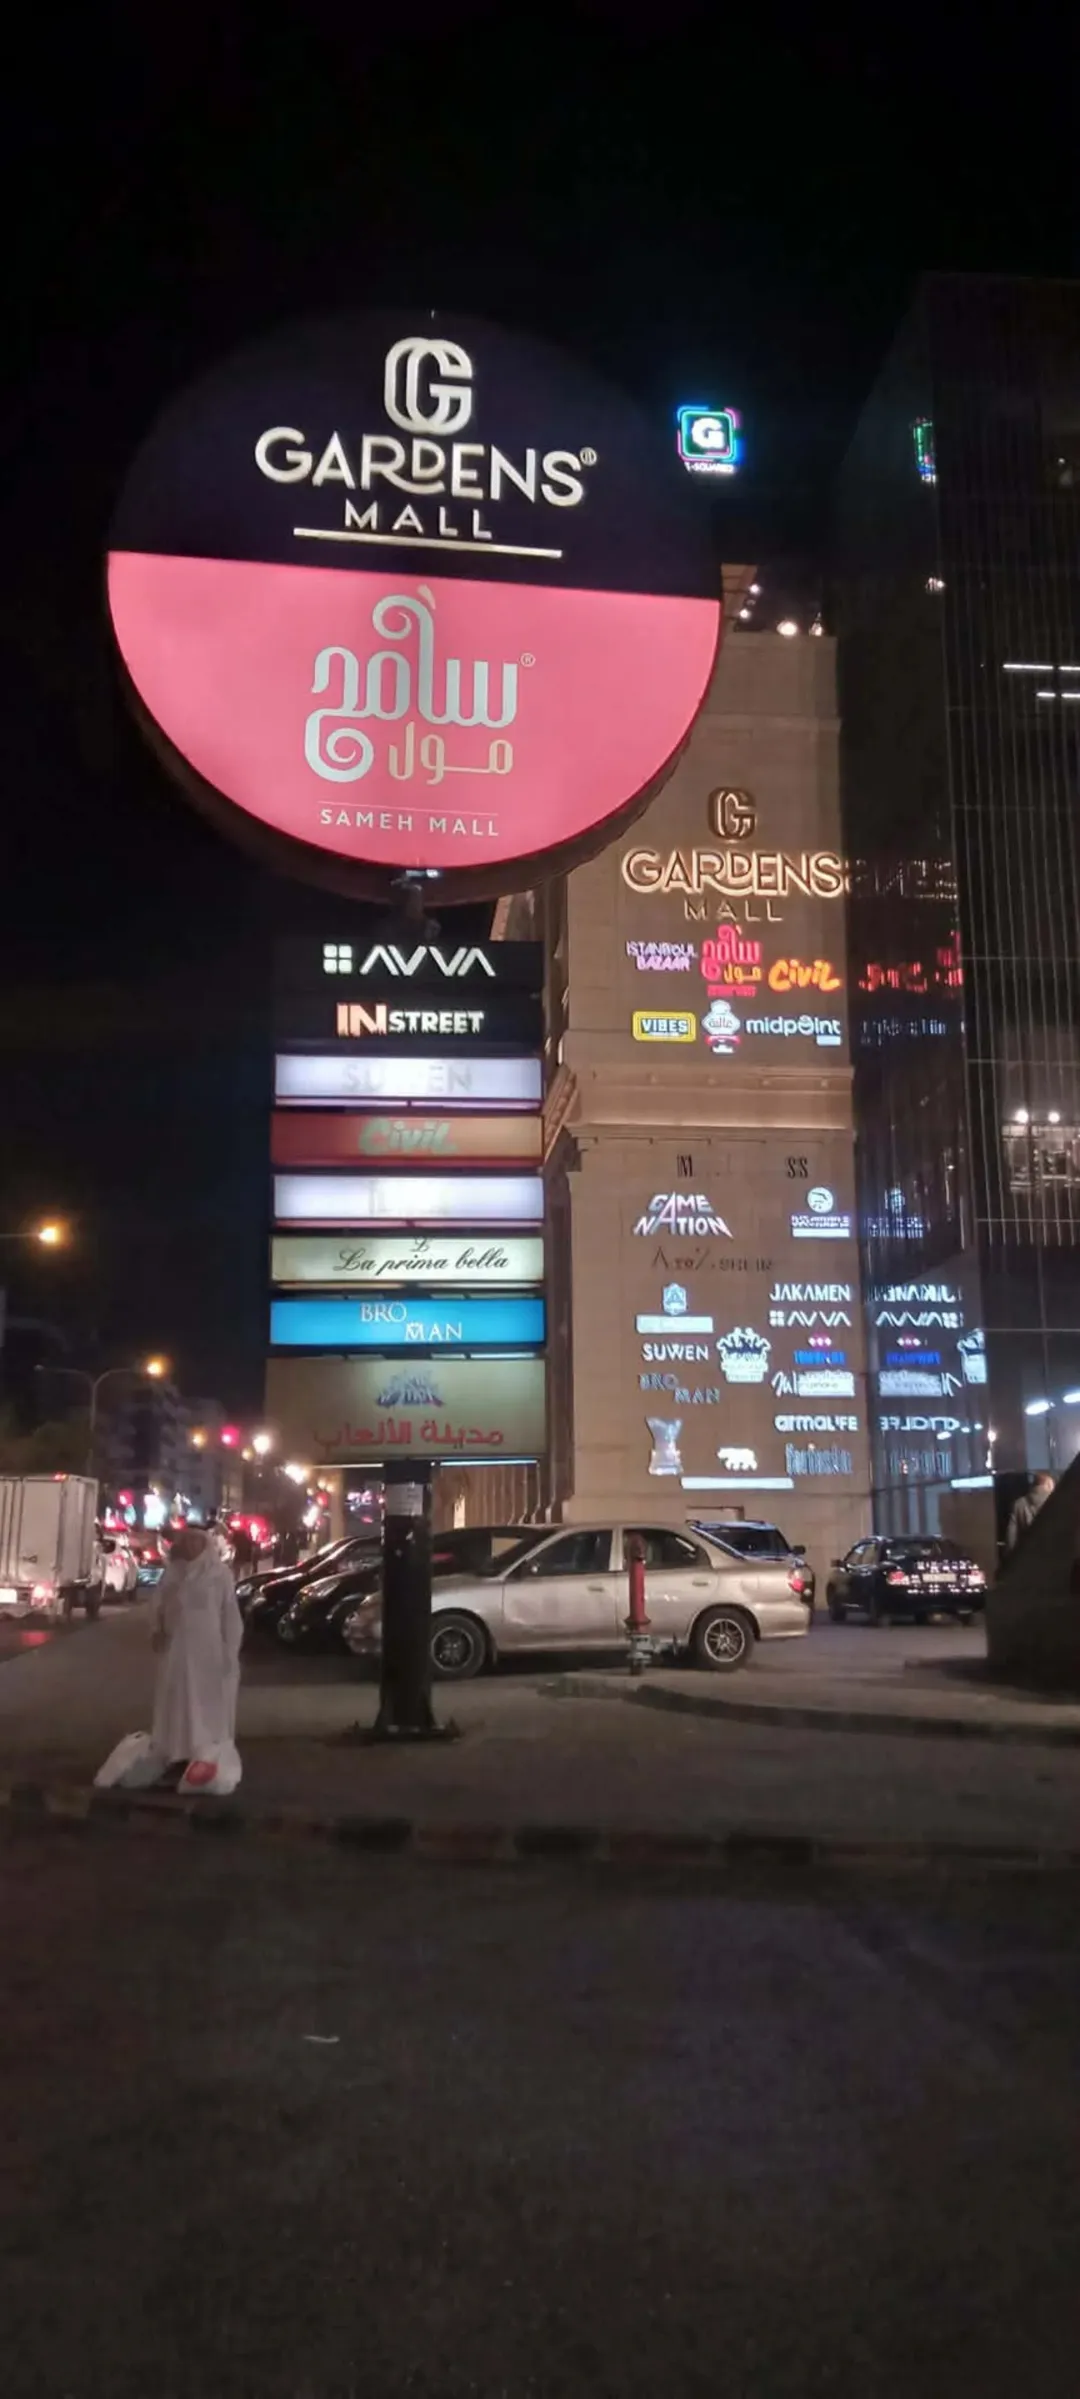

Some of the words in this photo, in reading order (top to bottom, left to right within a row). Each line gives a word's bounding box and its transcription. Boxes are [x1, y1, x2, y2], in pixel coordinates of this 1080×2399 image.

[255, 427, 587, 507] GARDENS
[344, 498, 495, 540] MALL
[303, 584, 519, 784] سامح
[387, 721, 515, 787] مول
[319, 808, 415, 833] SAMEH
[428, 815, 500, 837] MALL
[621, 848, 843, 900] GARDENS
[683, 899, 784, 923] MALL
[359, 944, 497, 978] AVVA
[640, 1018, 690, 1034] VIBES
[341, 1063, 475, 1093] SUEN
[646, 1190, 714, 1215] GAME
[632, 1211, 736, 1243] NATION
[333, 1246, 376, 1272] La
[375, 1255, 450, 1276] prima
[454, 1247, 511, 1270] bella
[769, 1283, 853, 1302] JAKAMEN
[360, 1301, 408, 1324] BRO
[786, 1310, 853, 1328] AVVA
[404, 1321, 464, 1342] MAN
[641, 1342, 710, 1362] SUWEN
[673, 1388, 722, 1405] MAN
